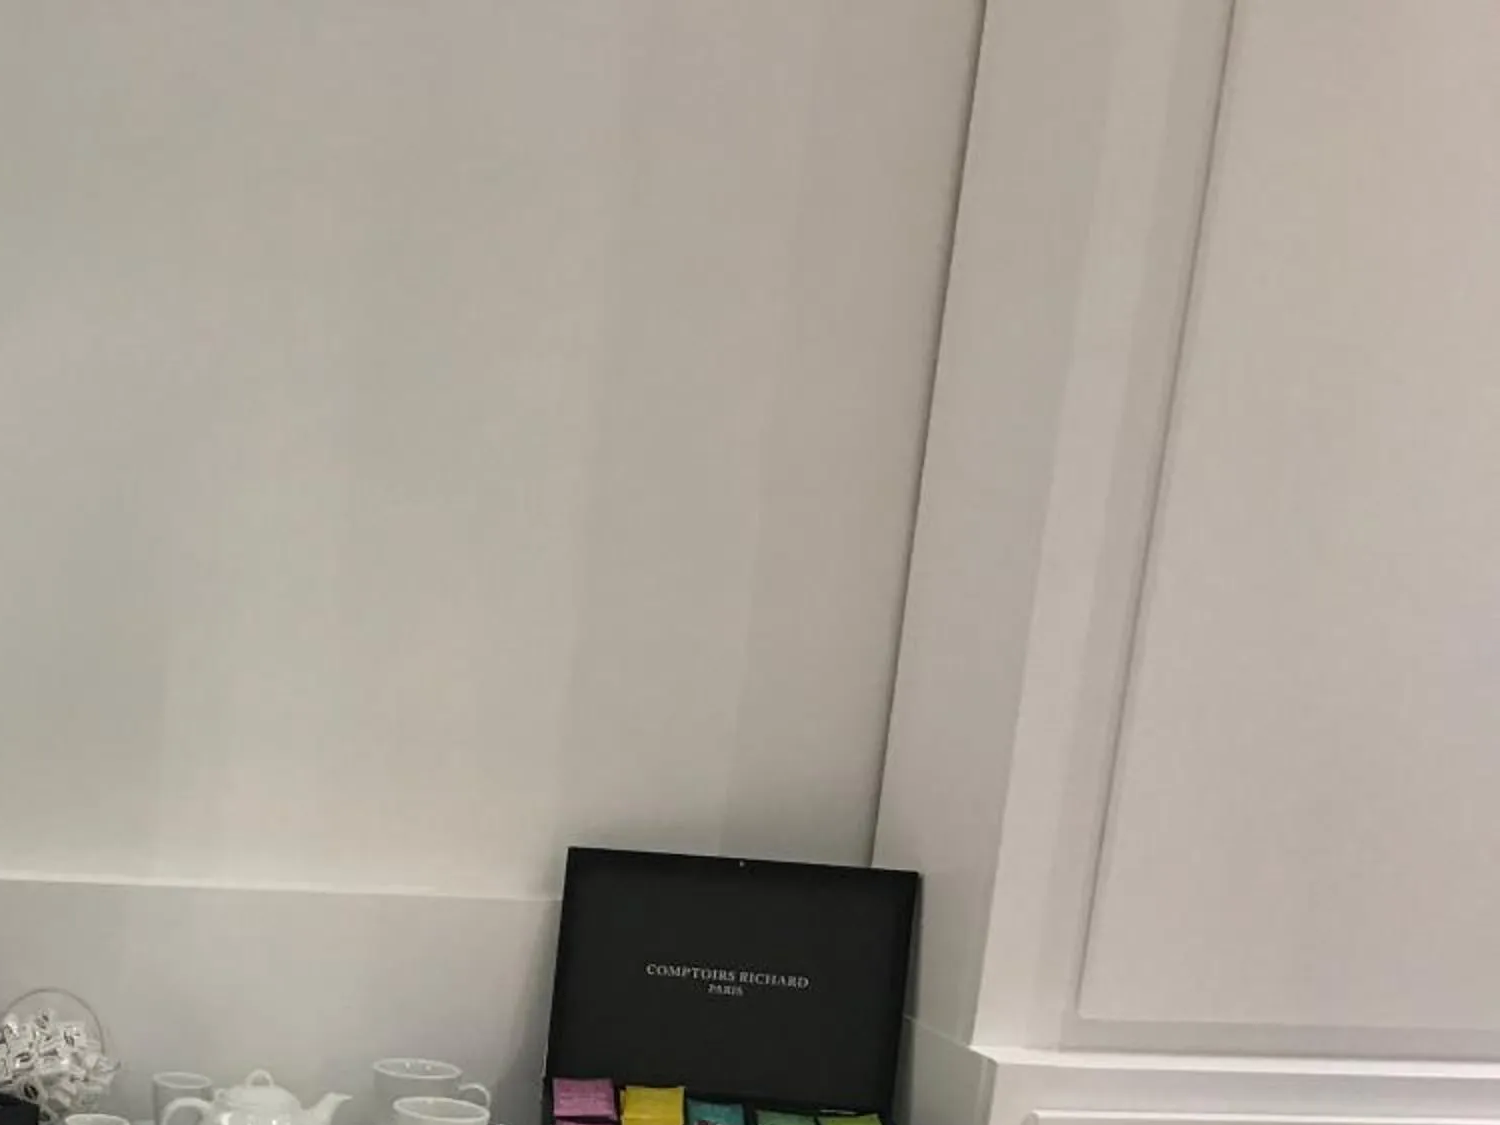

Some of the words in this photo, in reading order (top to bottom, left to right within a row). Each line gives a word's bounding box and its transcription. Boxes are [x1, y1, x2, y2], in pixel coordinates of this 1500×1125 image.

[646, 963, 735, 982] COMPTOIRS
[739, 971, 809, 989] RICHARD
[708, 983, 743, 996] PARIS
